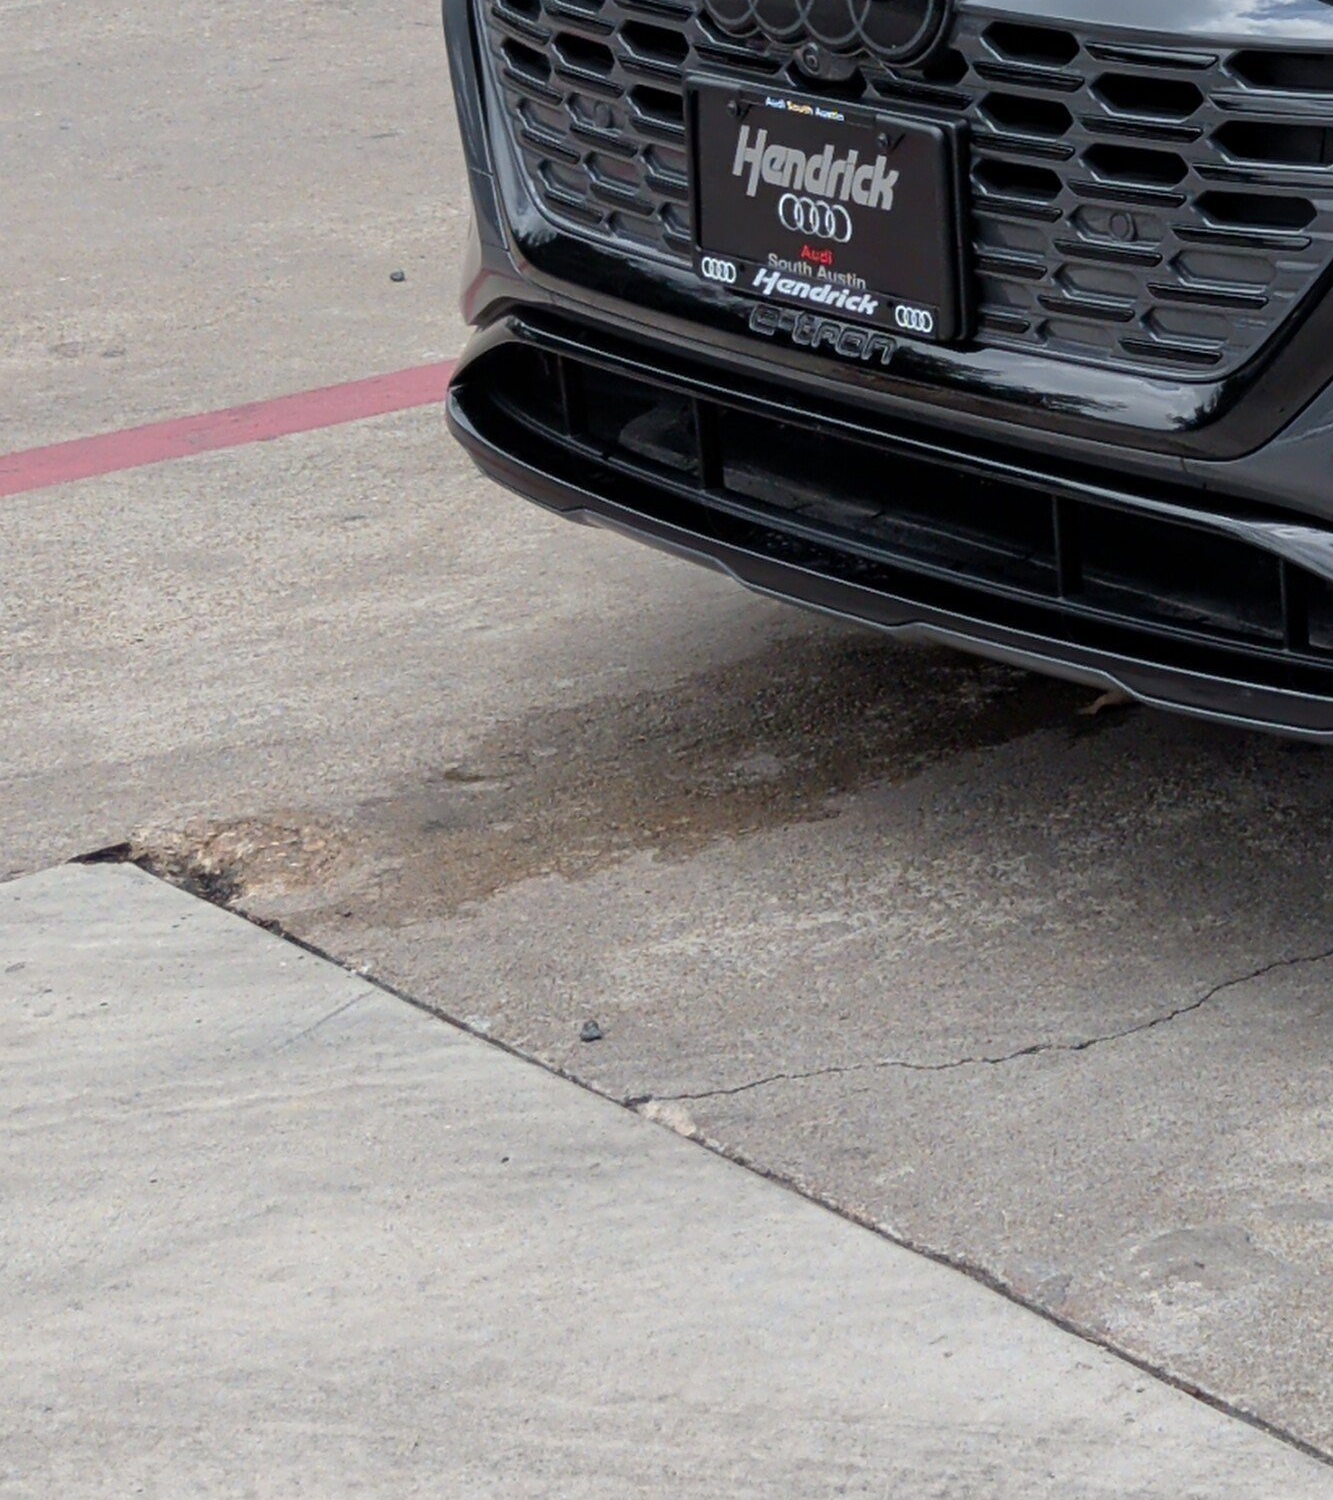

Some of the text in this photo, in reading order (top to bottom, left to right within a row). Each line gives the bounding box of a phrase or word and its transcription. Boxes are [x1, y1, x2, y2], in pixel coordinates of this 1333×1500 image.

[732, 125, 899, 211] Hendrick
[768, 252, 867, 290] South Austin
[801, 245, 833, 265] Audi
[752, 268, 879, 316] Hendrick
